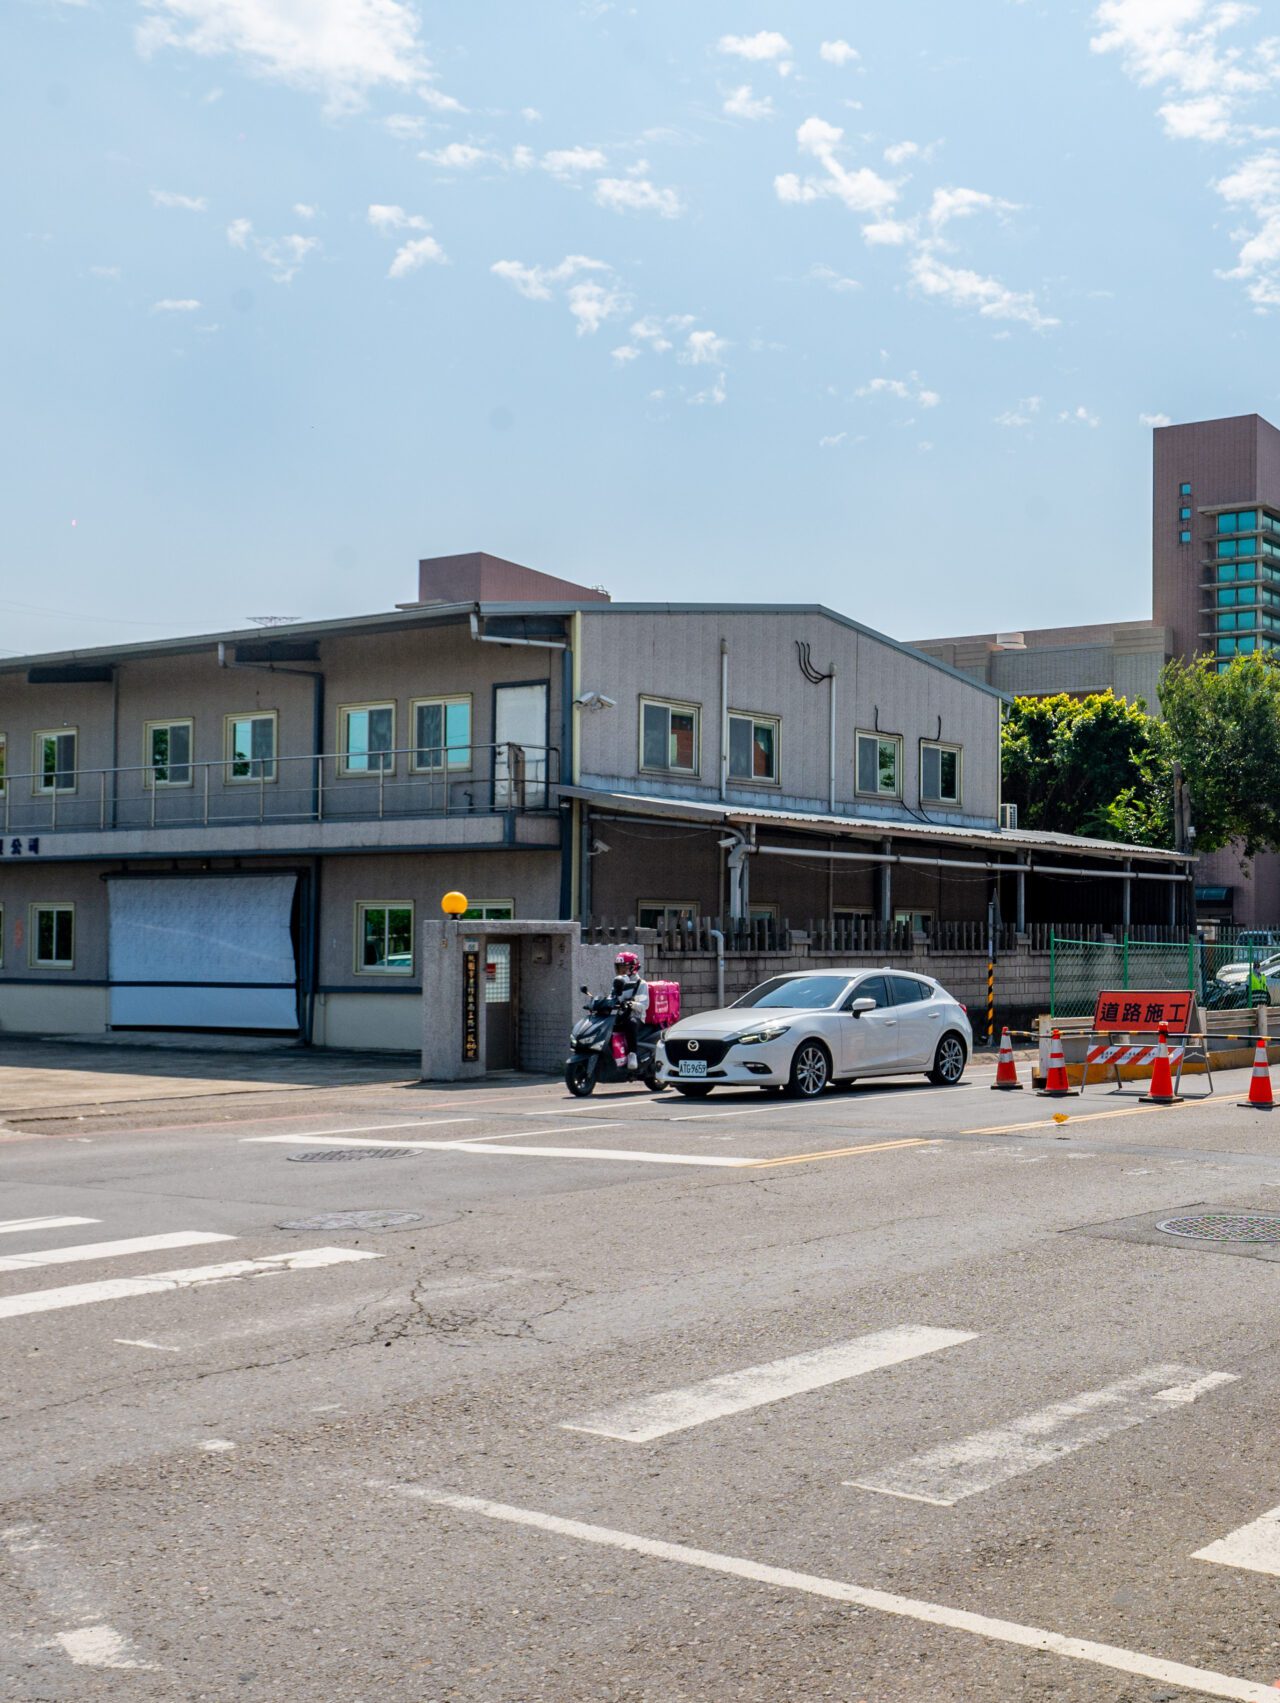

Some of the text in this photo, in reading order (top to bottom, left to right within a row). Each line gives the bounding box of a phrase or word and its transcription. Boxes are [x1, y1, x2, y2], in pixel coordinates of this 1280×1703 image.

[0, 837, 39, 855] 公司
[1099, 1001, 1186, 1023] 道路施工
